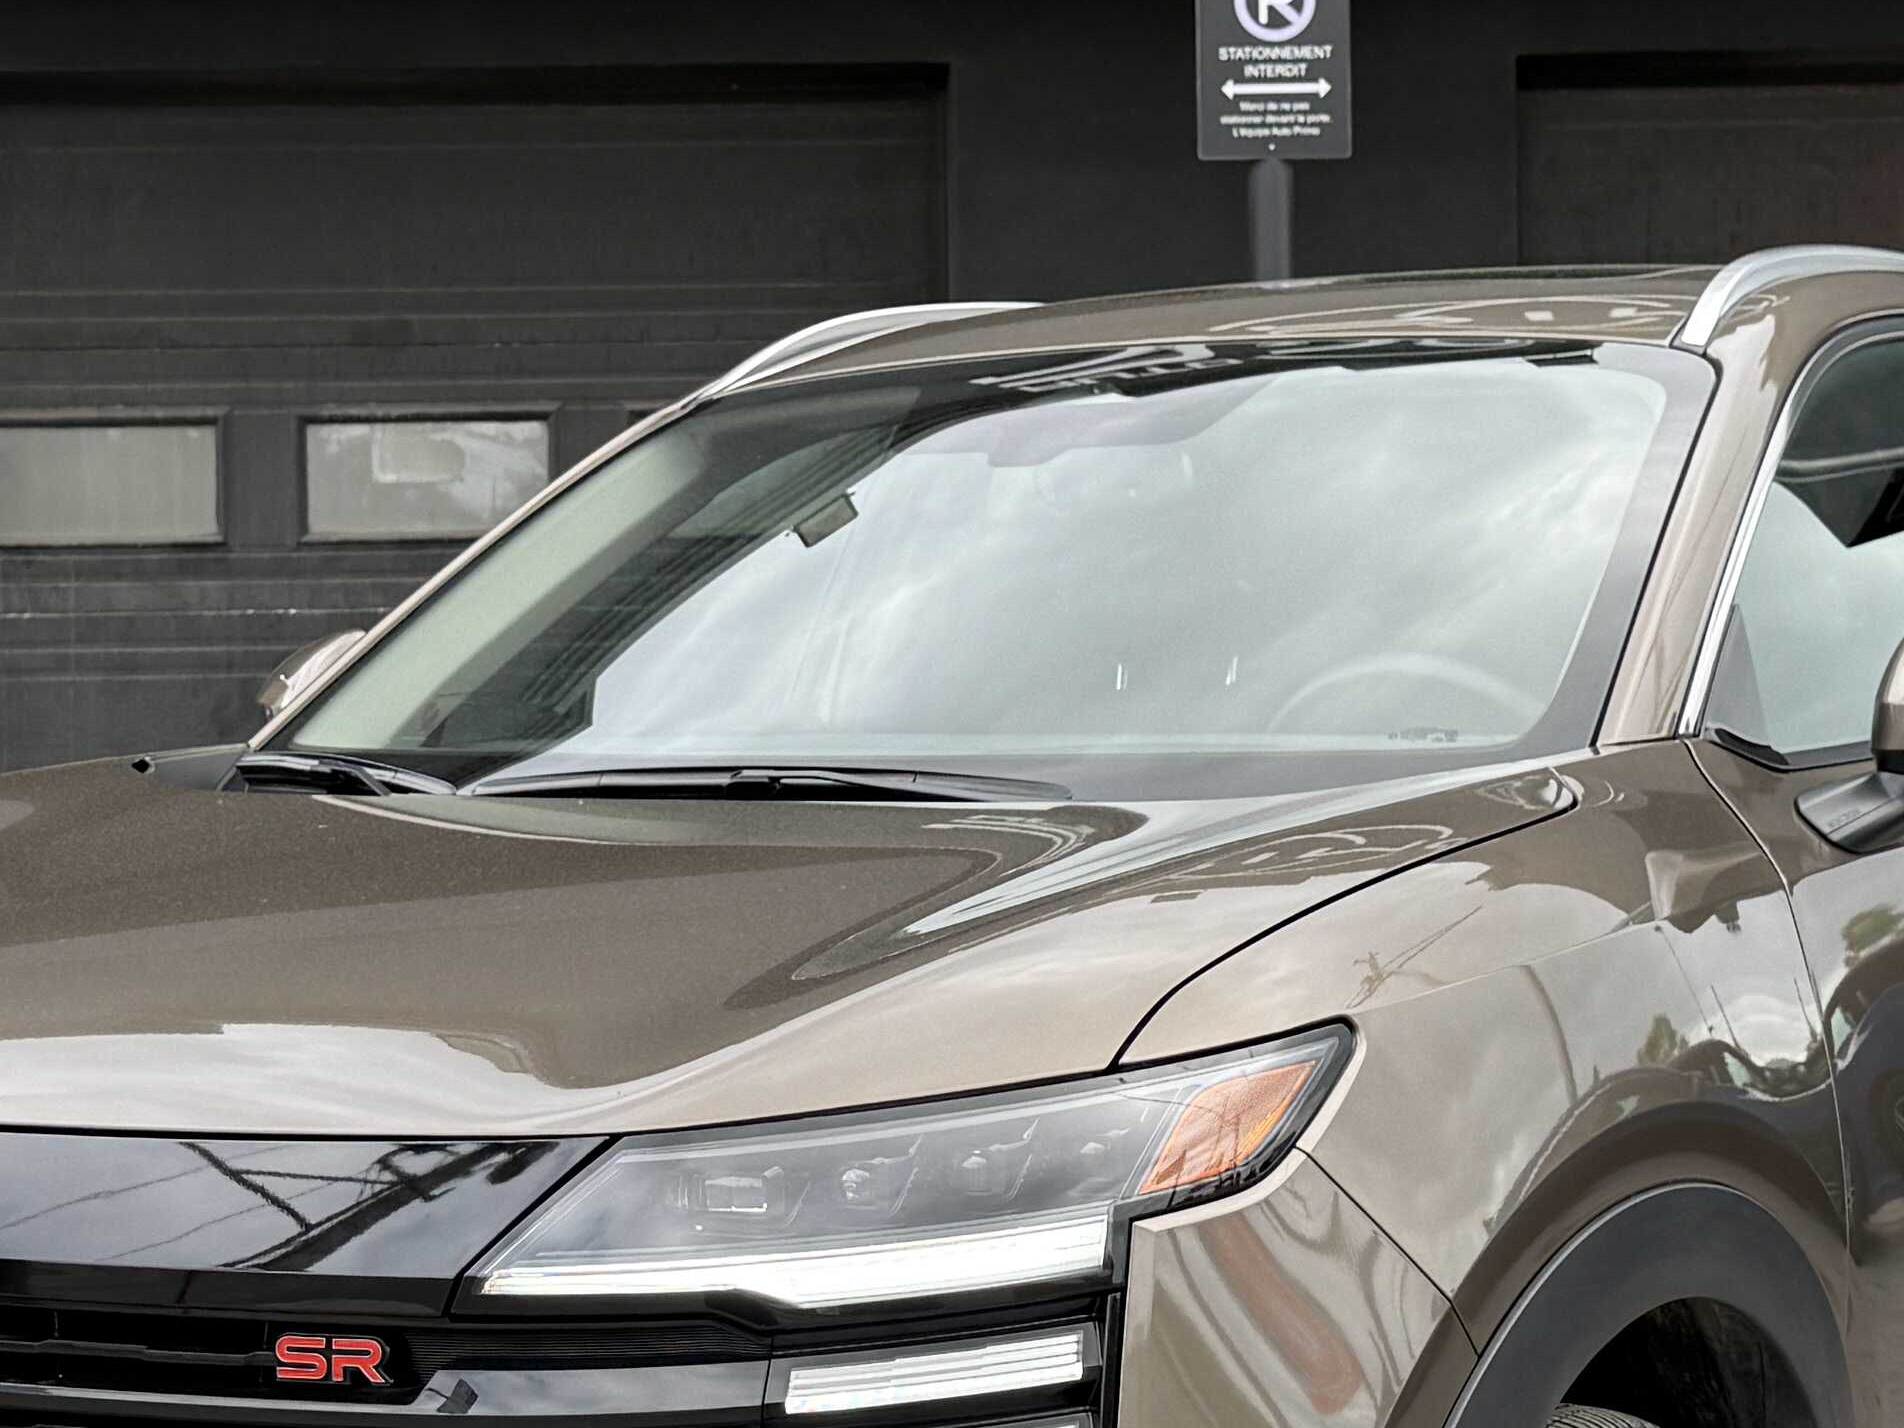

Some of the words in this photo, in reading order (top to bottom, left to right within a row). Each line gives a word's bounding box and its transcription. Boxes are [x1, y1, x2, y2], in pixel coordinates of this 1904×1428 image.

[1218, 44, 1333, 61] STATIONNEMENT
[1243, 63, 1308, 78] INTERDIT
[275, 1333, 388, 1384] SR
